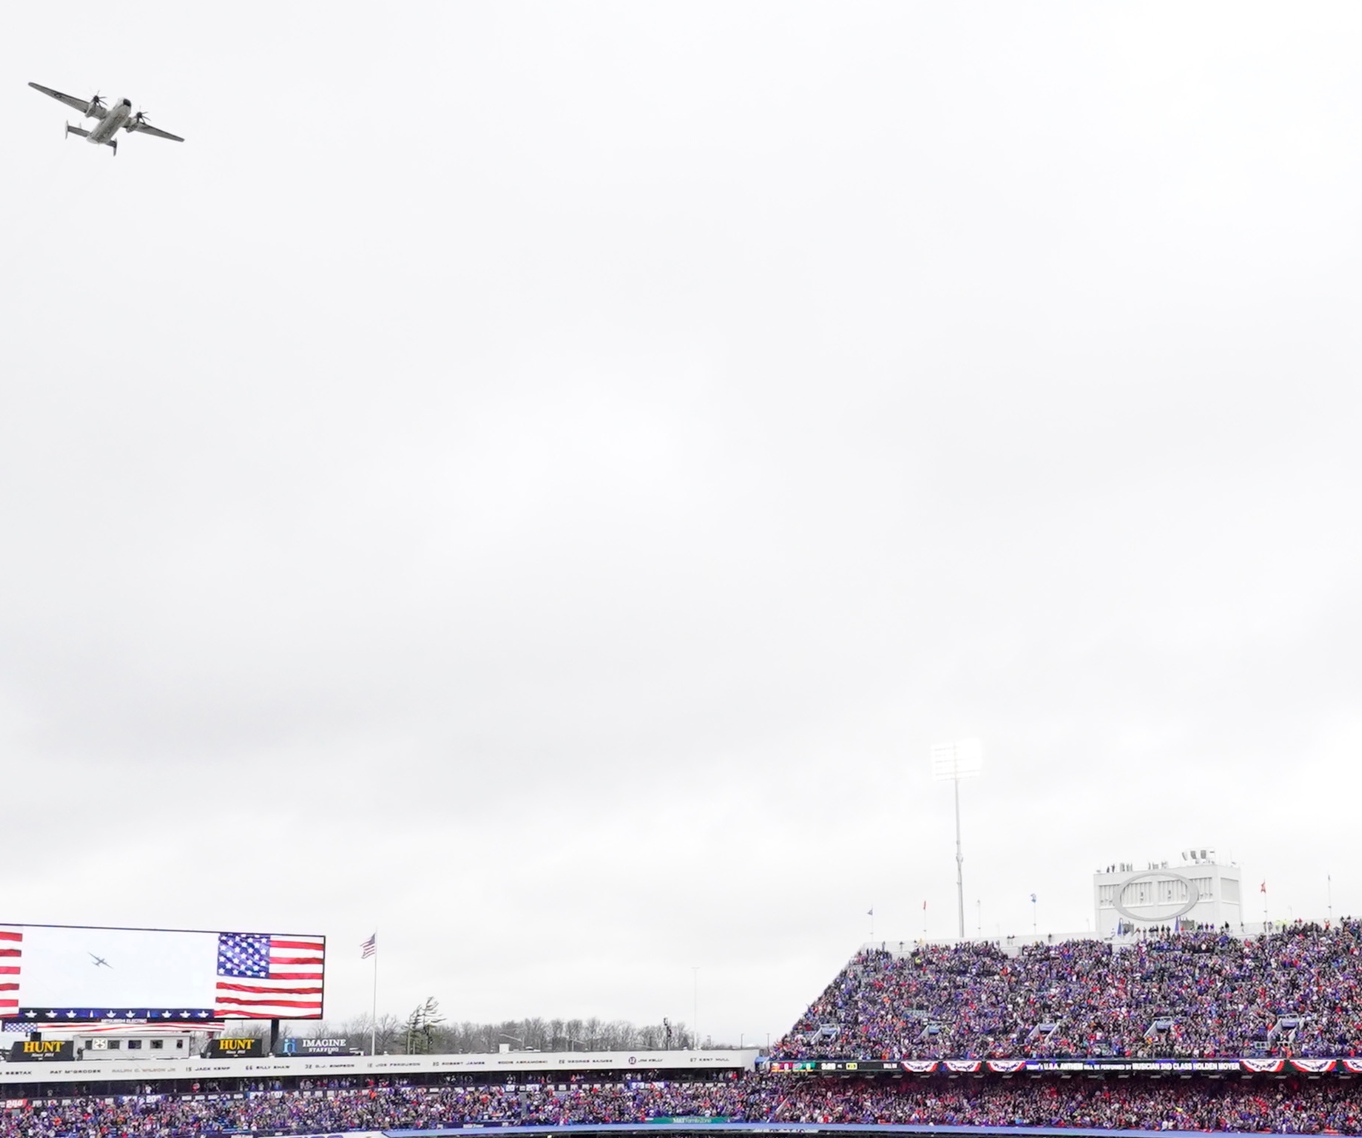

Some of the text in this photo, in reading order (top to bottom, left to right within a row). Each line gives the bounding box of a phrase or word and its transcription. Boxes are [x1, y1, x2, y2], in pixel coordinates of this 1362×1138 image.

[23, 1041, 65, 1053] HUNT
[219, 1039, 255, 1050] HUNT
[302, 1039, 347, 1048] IMAGINE
